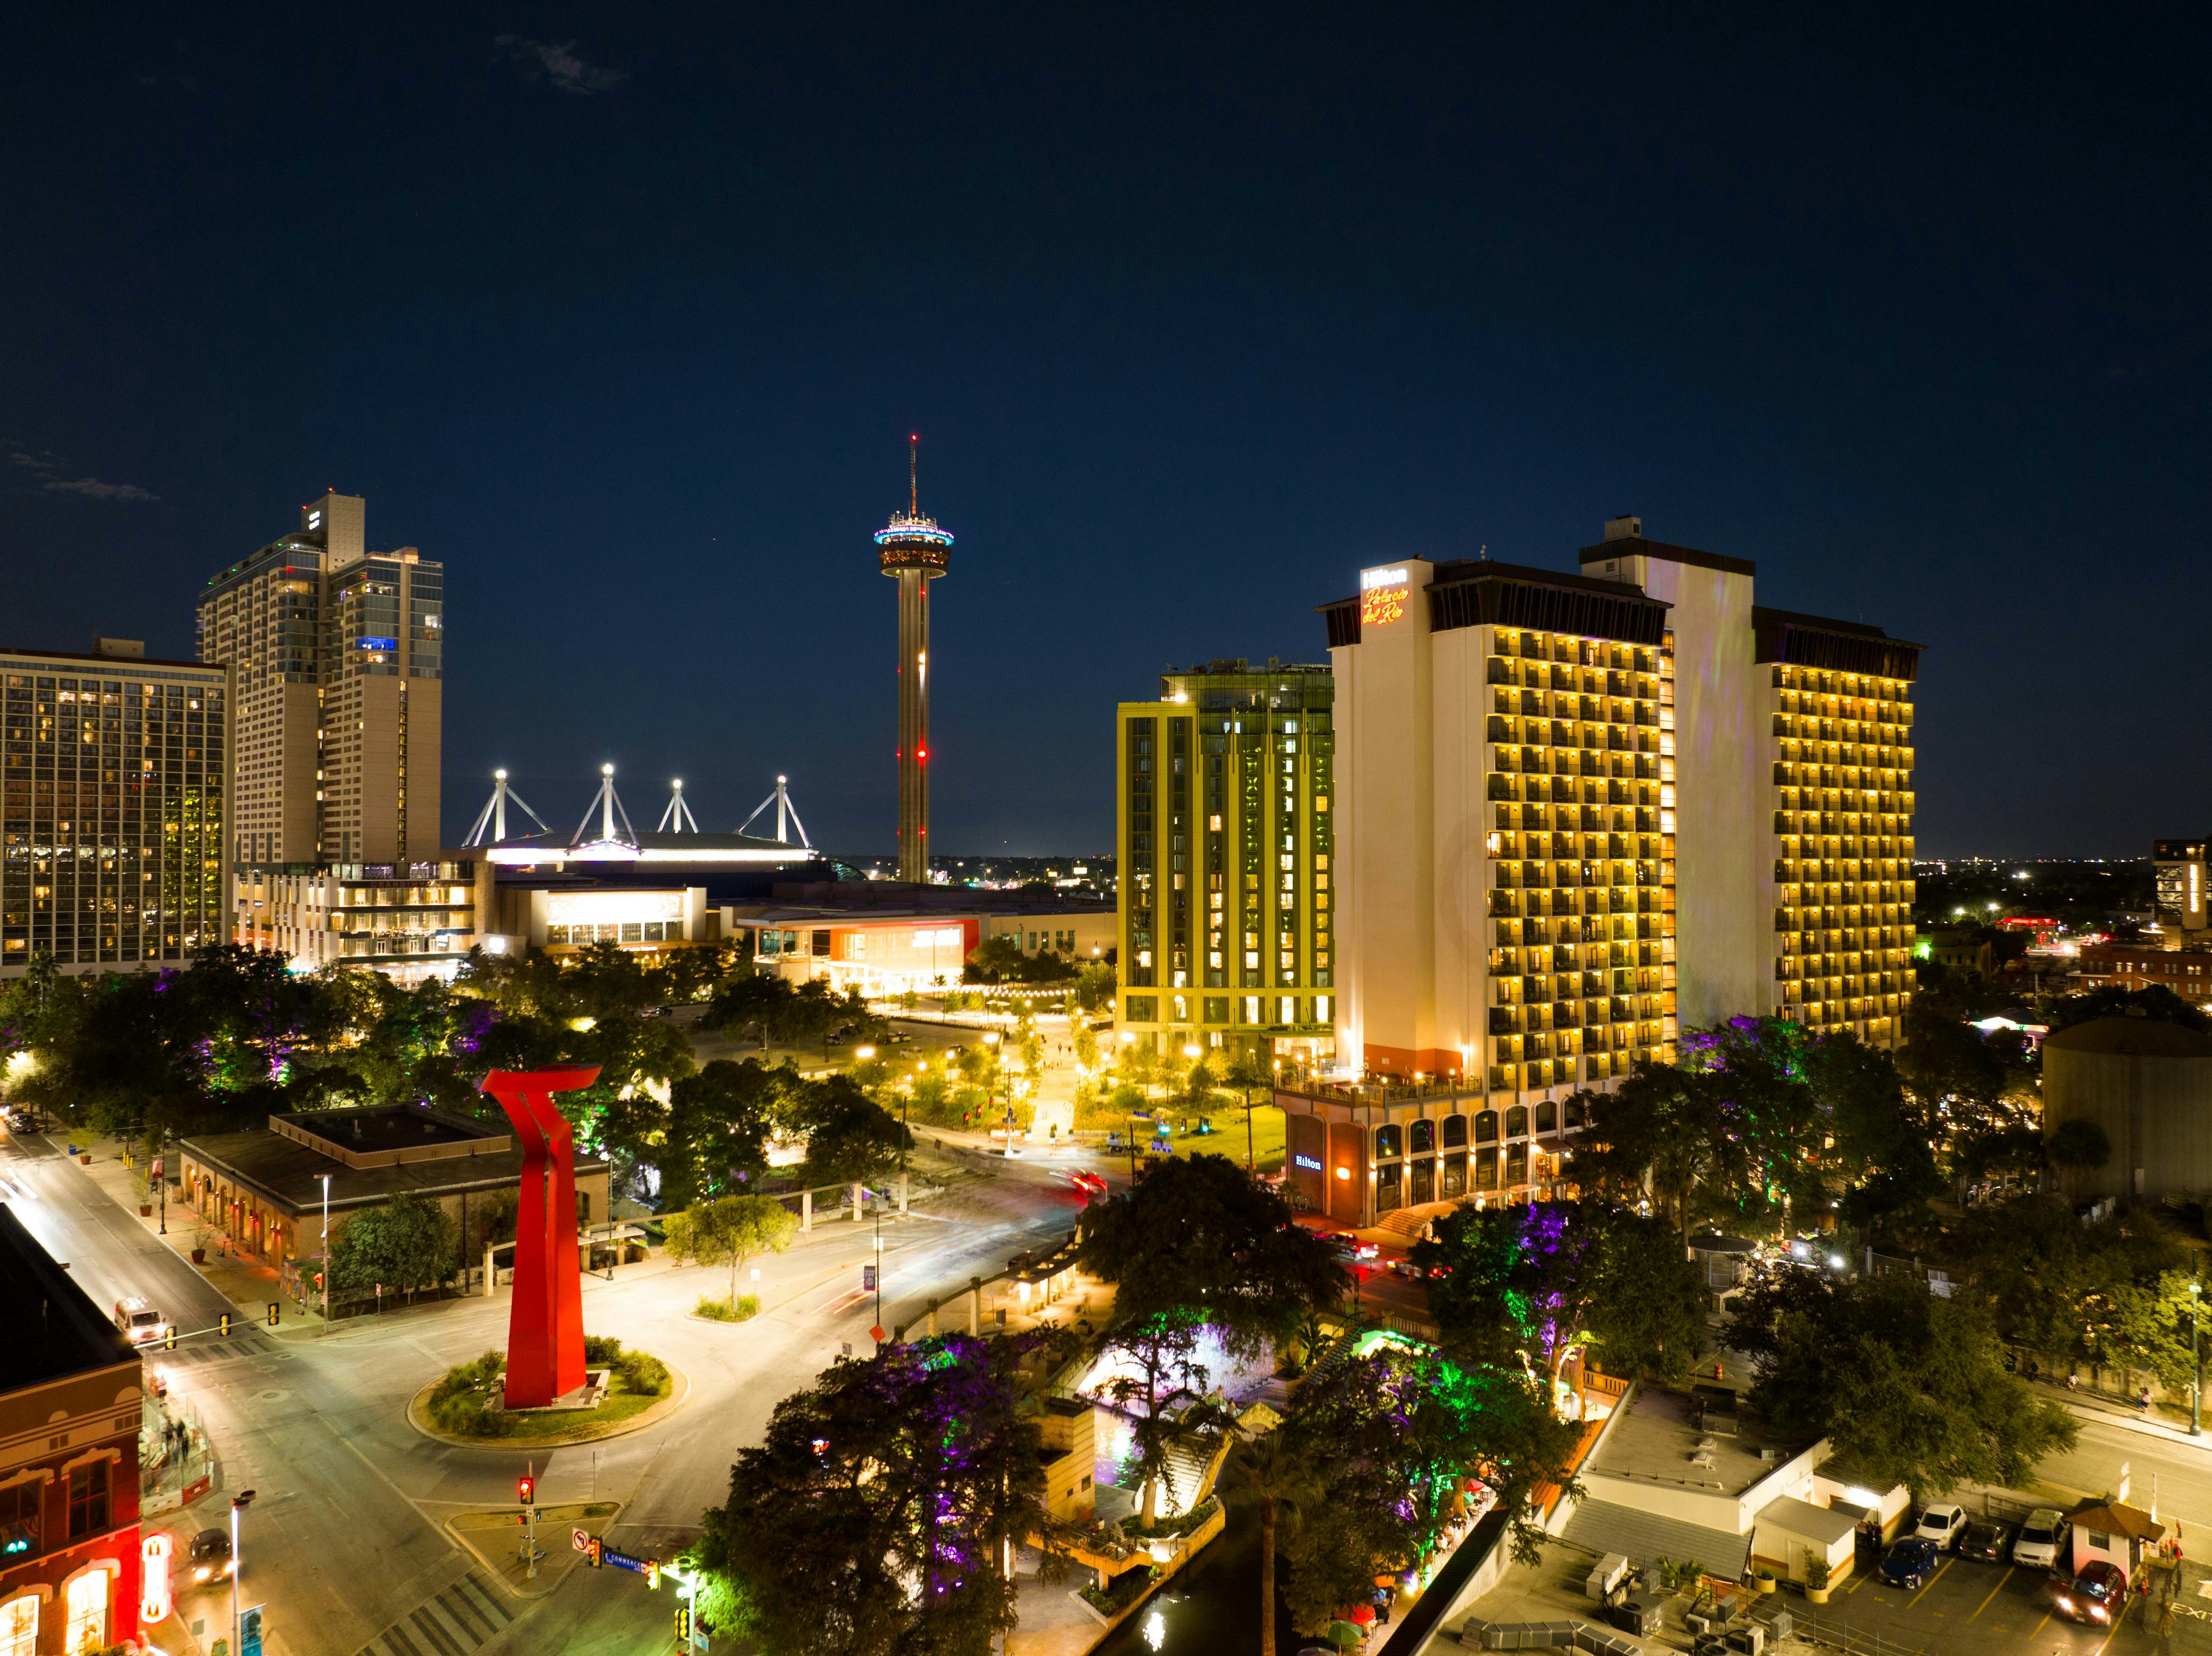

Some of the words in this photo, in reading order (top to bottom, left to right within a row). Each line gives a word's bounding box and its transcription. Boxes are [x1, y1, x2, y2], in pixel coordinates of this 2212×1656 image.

[1363, 586, 1409, 609] Palacio
[1362, 607, 1381, 624] del
[1296, 1155, 1321, 1171] Hilton
[611, 1554, 641, 1568] COMMERCE
